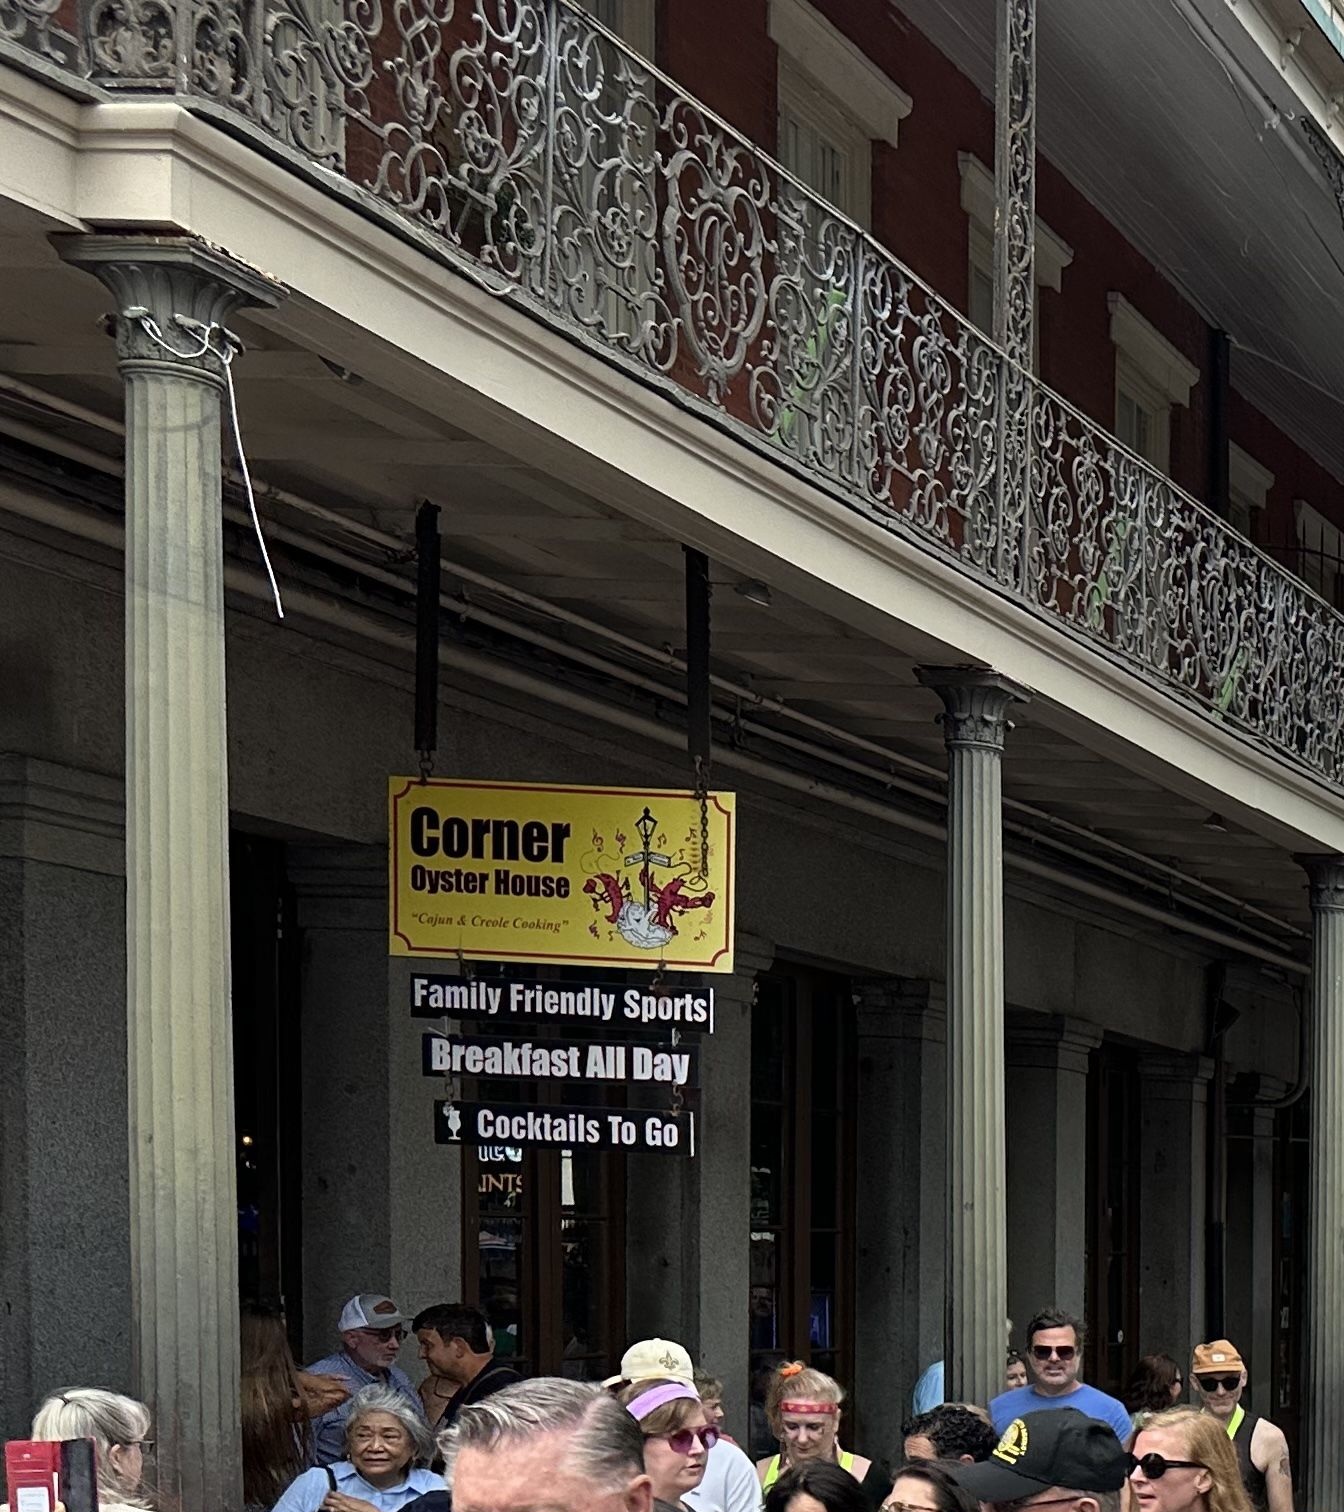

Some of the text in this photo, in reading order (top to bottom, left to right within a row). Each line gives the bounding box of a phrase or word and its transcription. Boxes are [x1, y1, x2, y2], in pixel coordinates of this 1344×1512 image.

[410, 806, 571, 863] Corner
[411, 864, 570, 899] Oyster House
[457, 915, 467, 926] &
[471, 915, 509, 929] Creole
[414, 978, 707, 1023] Family Friendly Sports
[431, 1037, 690, 1085] Breakfast All Day
[477, 1109, 678, 1147] Cocktails To Go
